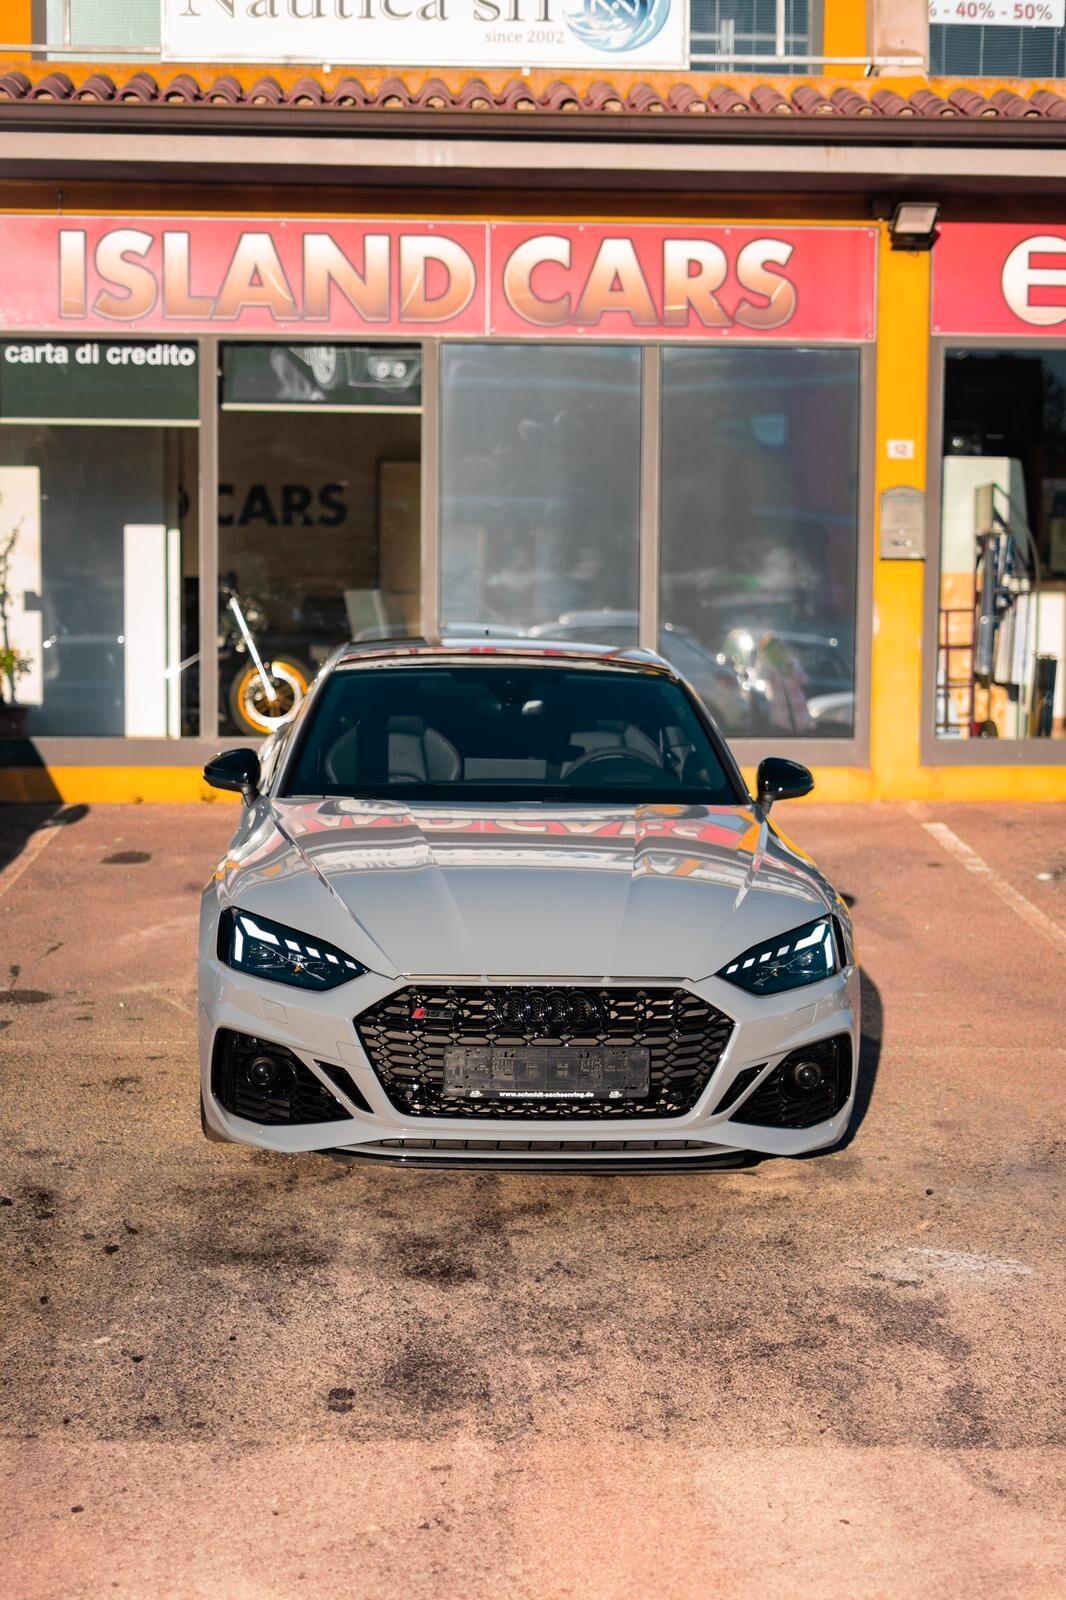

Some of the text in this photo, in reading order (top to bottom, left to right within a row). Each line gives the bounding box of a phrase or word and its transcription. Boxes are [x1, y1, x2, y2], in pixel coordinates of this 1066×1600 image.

[956, 2, 995, 18] 40%
[1013, 3, 1053, 20] 50%
[485, 30, 565, 44] since 2002
[57, 228, 798, 330] ISLAND CARS
[4, 343, 196, 366] carta di credito
[499, 1091, 594, 1099] www.schmidt-sachsenring.de
